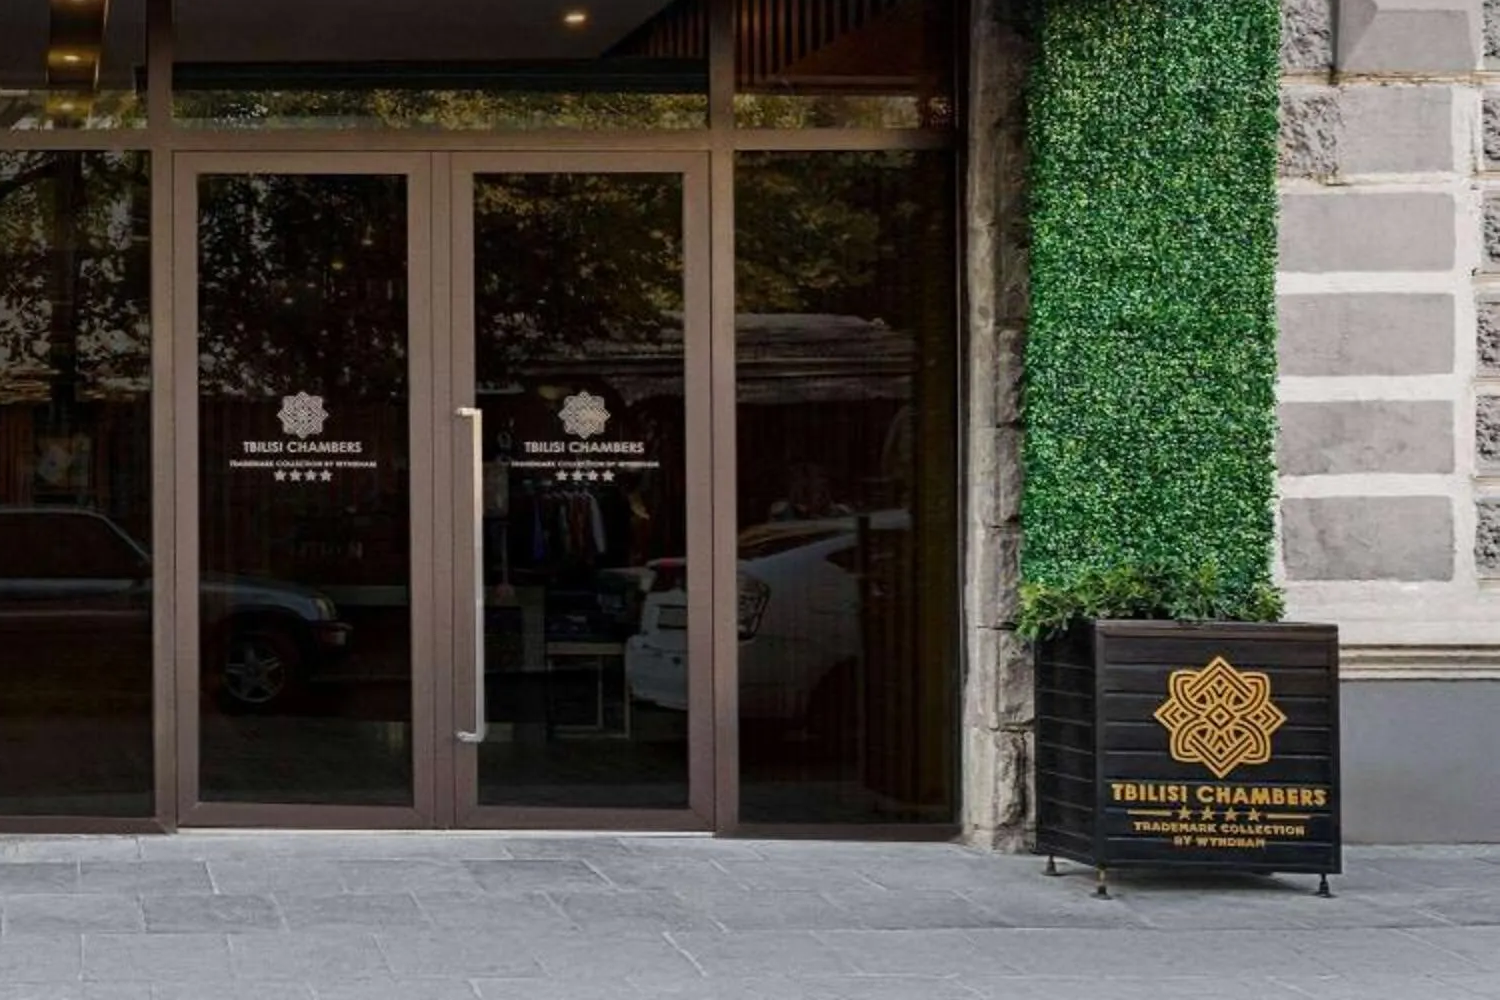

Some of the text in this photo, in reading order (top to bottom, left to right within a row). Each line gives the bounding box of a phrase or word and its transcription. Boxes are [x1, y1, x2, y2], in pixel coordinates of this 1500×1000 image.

[243, 441, 362, 453] TBILISI CHAMBERS
[525, 441, 645, 453] TBILISI CHAMBERS
[1111, 784, 1326, 806] TBILISI CHAMBERS
[1134, 821, 1305, 835] TRADEMARK COLLECTION
